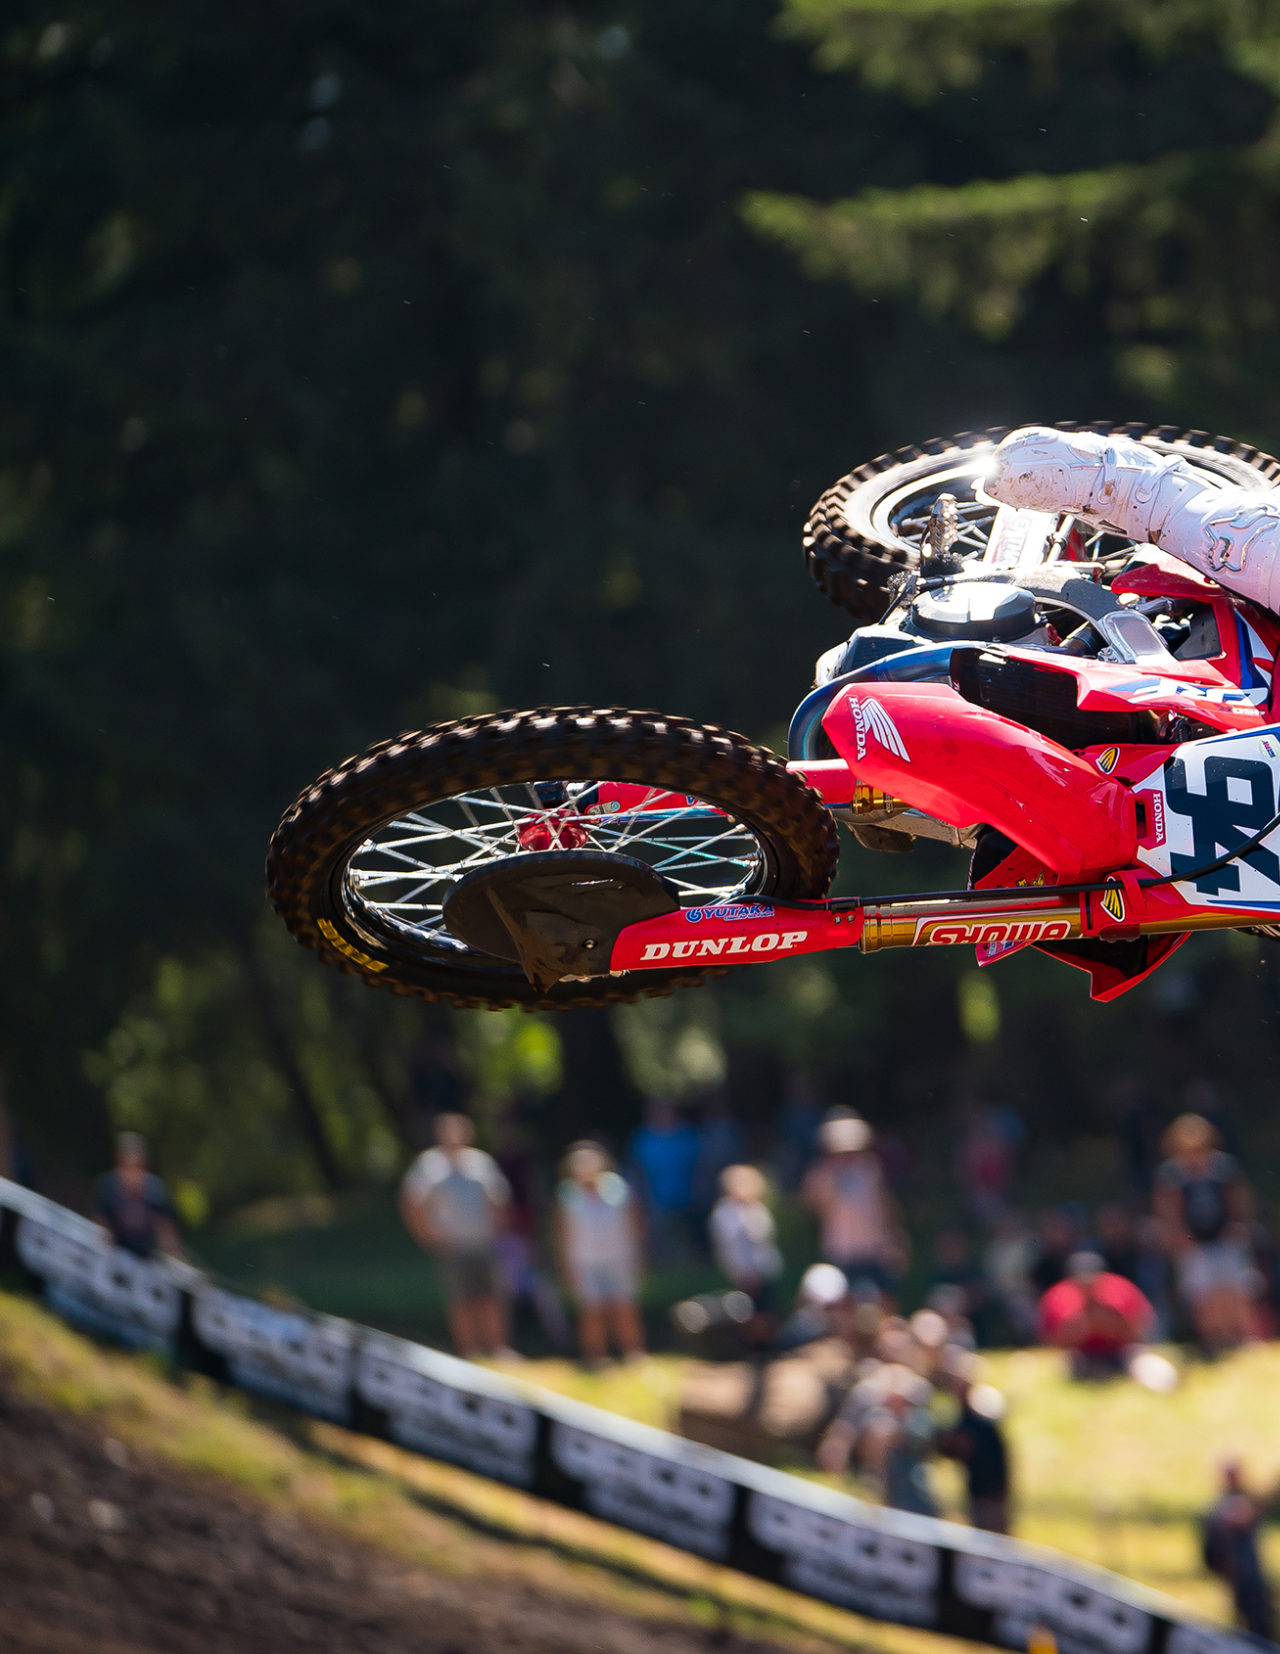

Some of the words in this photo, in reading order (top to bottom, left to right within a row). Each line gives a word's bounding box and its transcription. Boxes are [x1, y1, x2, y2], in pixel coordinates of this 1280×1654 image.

[849, 696, 867, 761] HONDA
[1152, 792, 1164, 844] HONDA
[704, 903, 776, 919] YUTAKA
[640, 930, 808, 961] DUNLOP
[931, 921, 1071, 944] SHOWA
